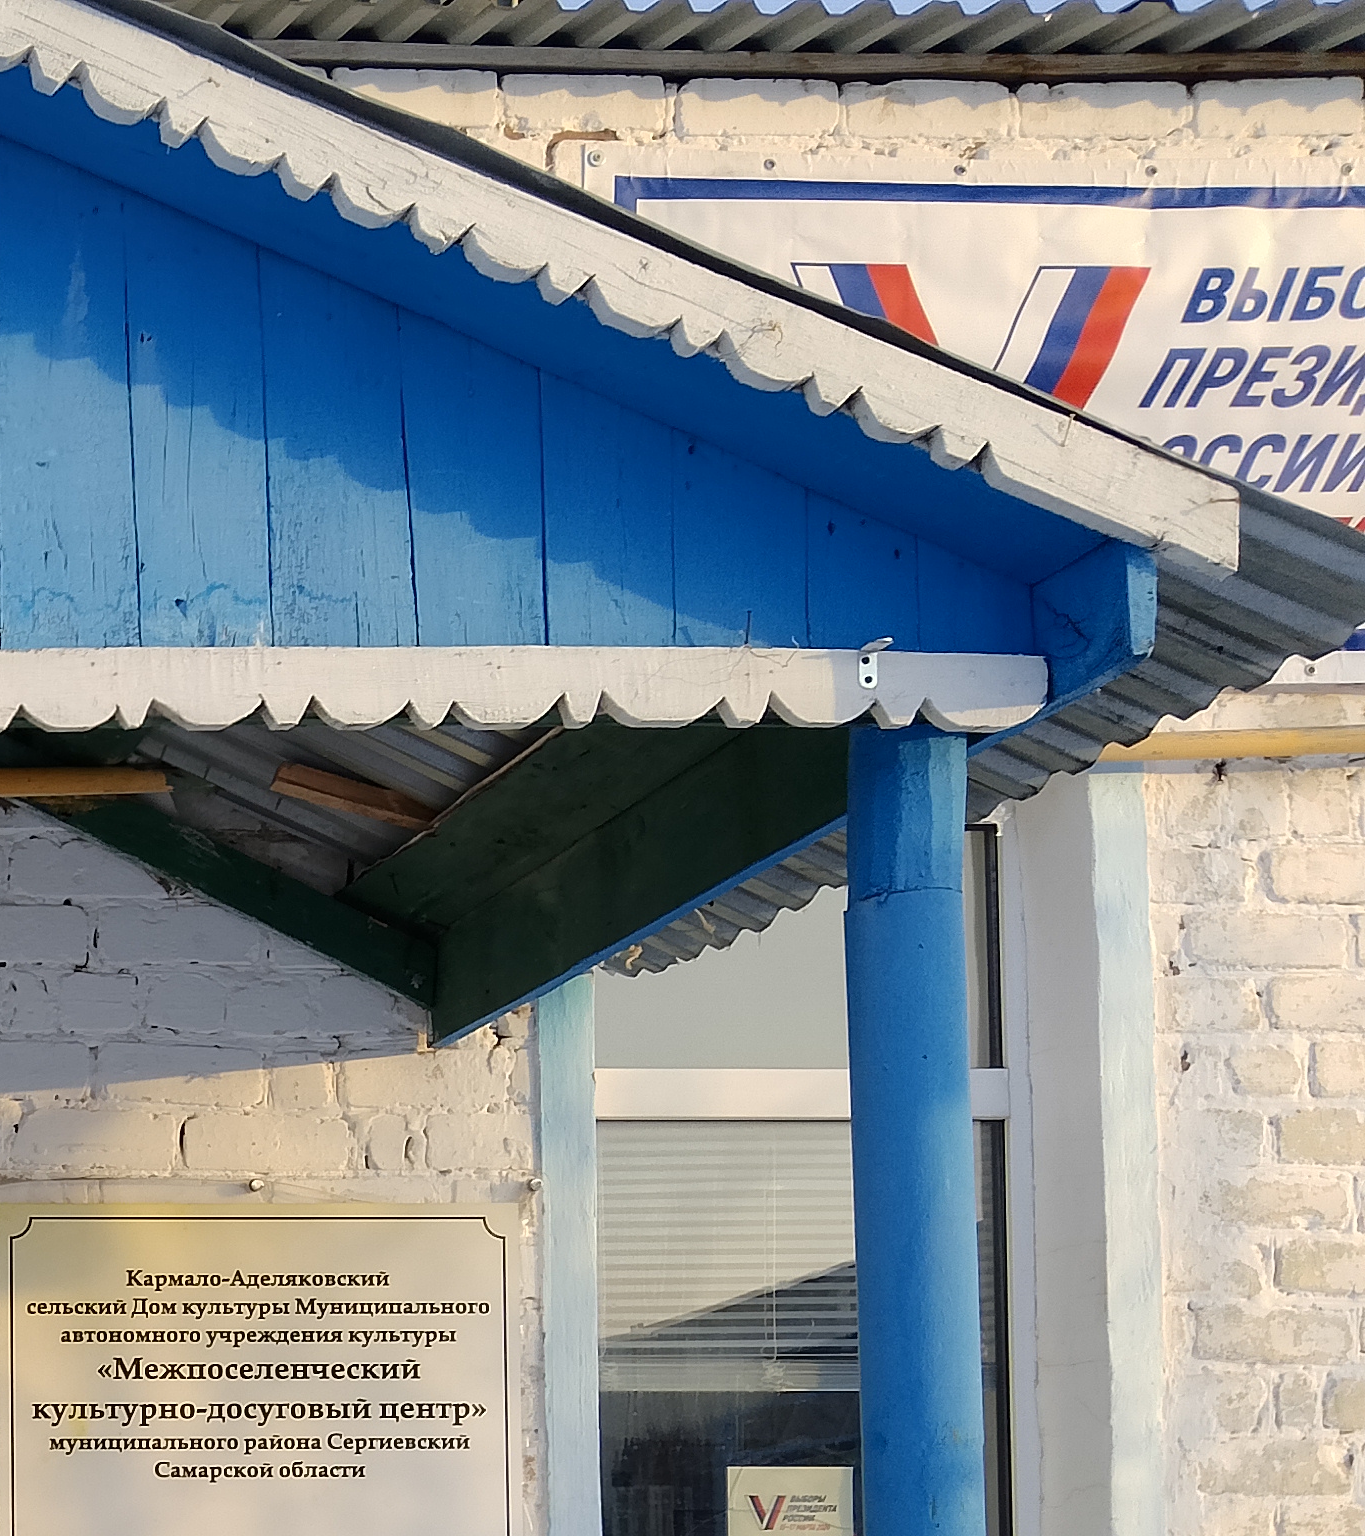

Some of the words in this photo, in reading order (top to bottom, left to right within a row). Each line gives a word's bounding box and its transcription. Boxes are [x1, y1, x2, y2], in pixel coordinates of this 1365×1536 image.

[1138, 345, 1365, 416] ПРЕЗИ
[126, 1269, 390, 1290] Кармало-Аделяковский
[26, 1298, 127, 1316] сельский
[130, 1299, 177, 1318] Дом
[181, 1302, 290, 1319] культуры
[295, 1299, 491, 1318] Муниципального
[60, 1329, 201, 1344] автономного
[205, 1329, 343, 1347] учреждения
[348, 1329, 457, 1347] культуры
[97, 1356, 421, 1381] «Межпоселенческий
[31, 1397, 371, 1424] культурно-досуговый
[378, 1401, 487, 1425] центр»
[49, 1436, 239, 1454] муниципального
[244, 1433, 322, 1454] района
[326, 1433, 471, 1455] Сергиевский
[154, 1460, 274, 1482] Самарской
[278, 1461, 366, 1479] области
